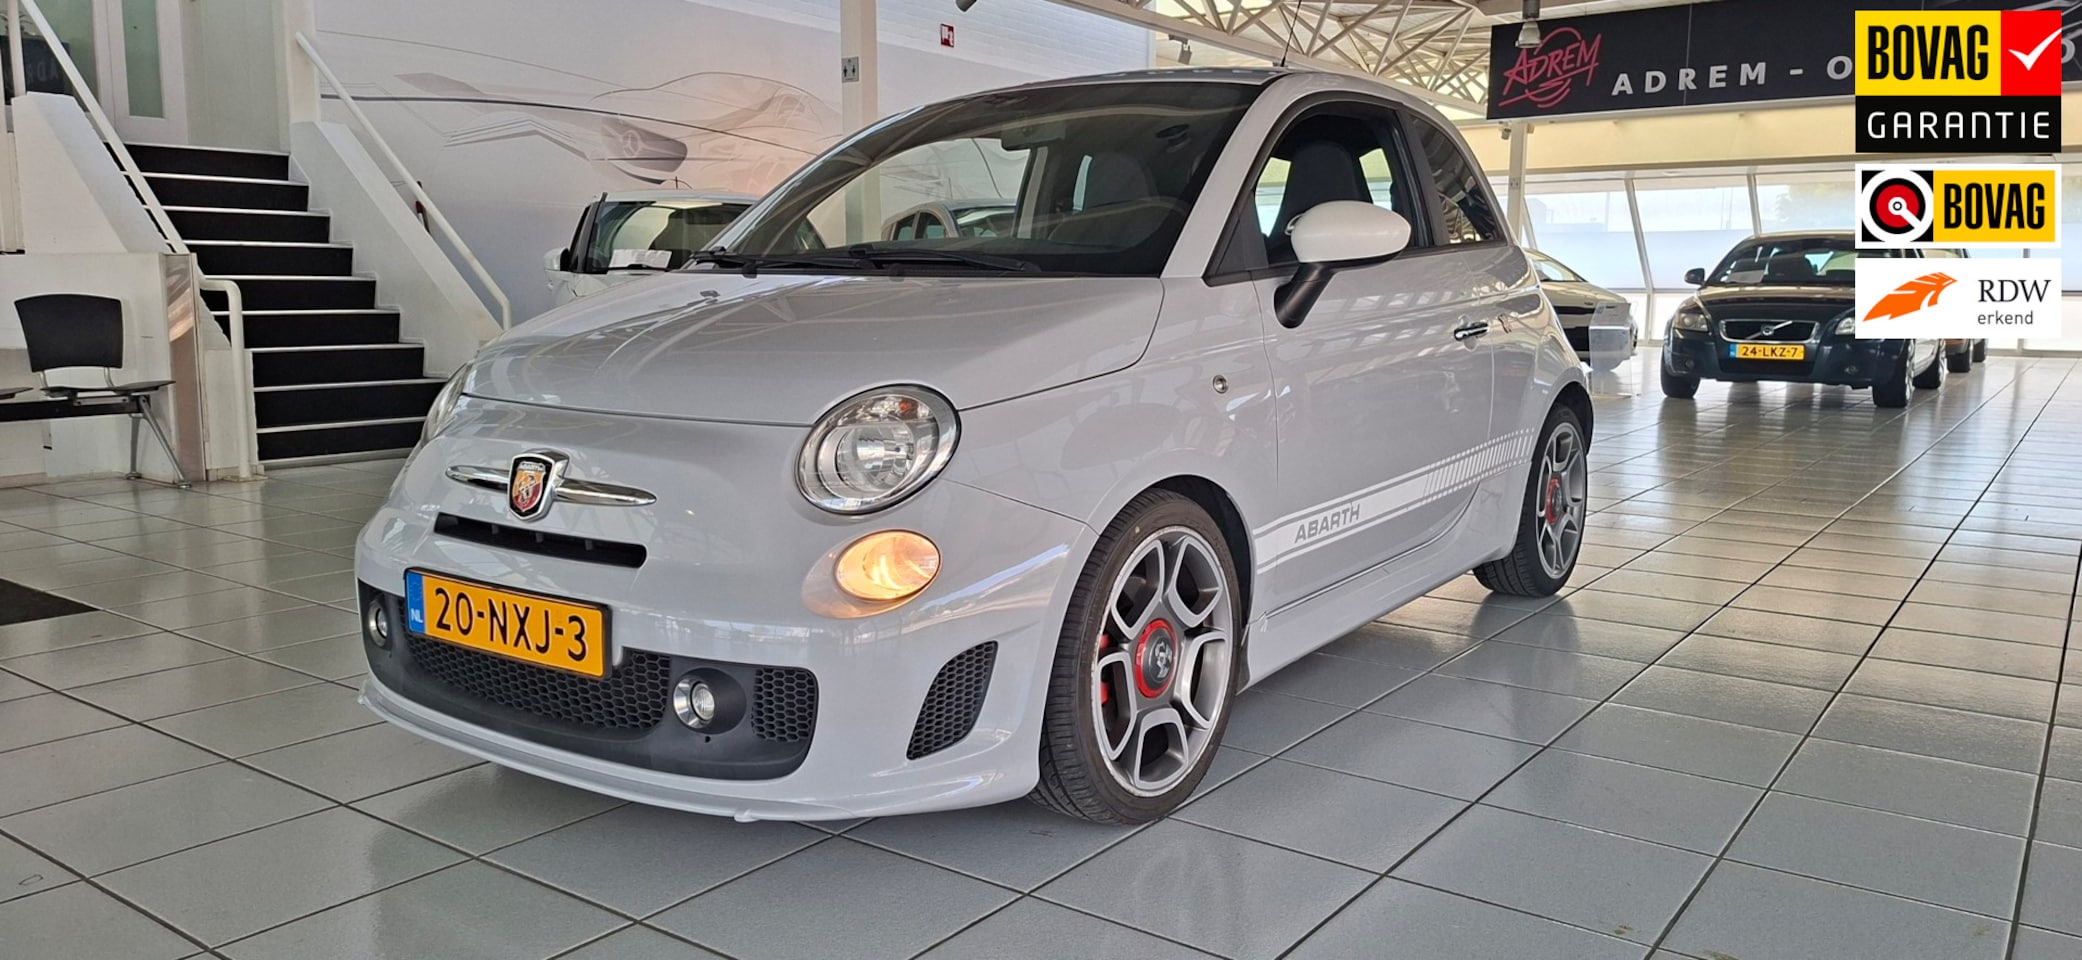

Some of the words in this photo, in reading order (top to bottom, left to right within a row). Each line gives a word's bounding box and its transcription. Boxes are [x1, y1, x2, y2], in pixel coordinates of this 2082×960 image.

[1503, 33, 1602, 96] ADREM
[1611, 61, 1767, 97] ADREM
[1741, 345, 1799, 359] 24-LKZ-7
[1294, 503, 1361, 544] ABARTH
[410, 607, 424, 623] NL
[435, 587, 588, 662] 20-NXJ-3
